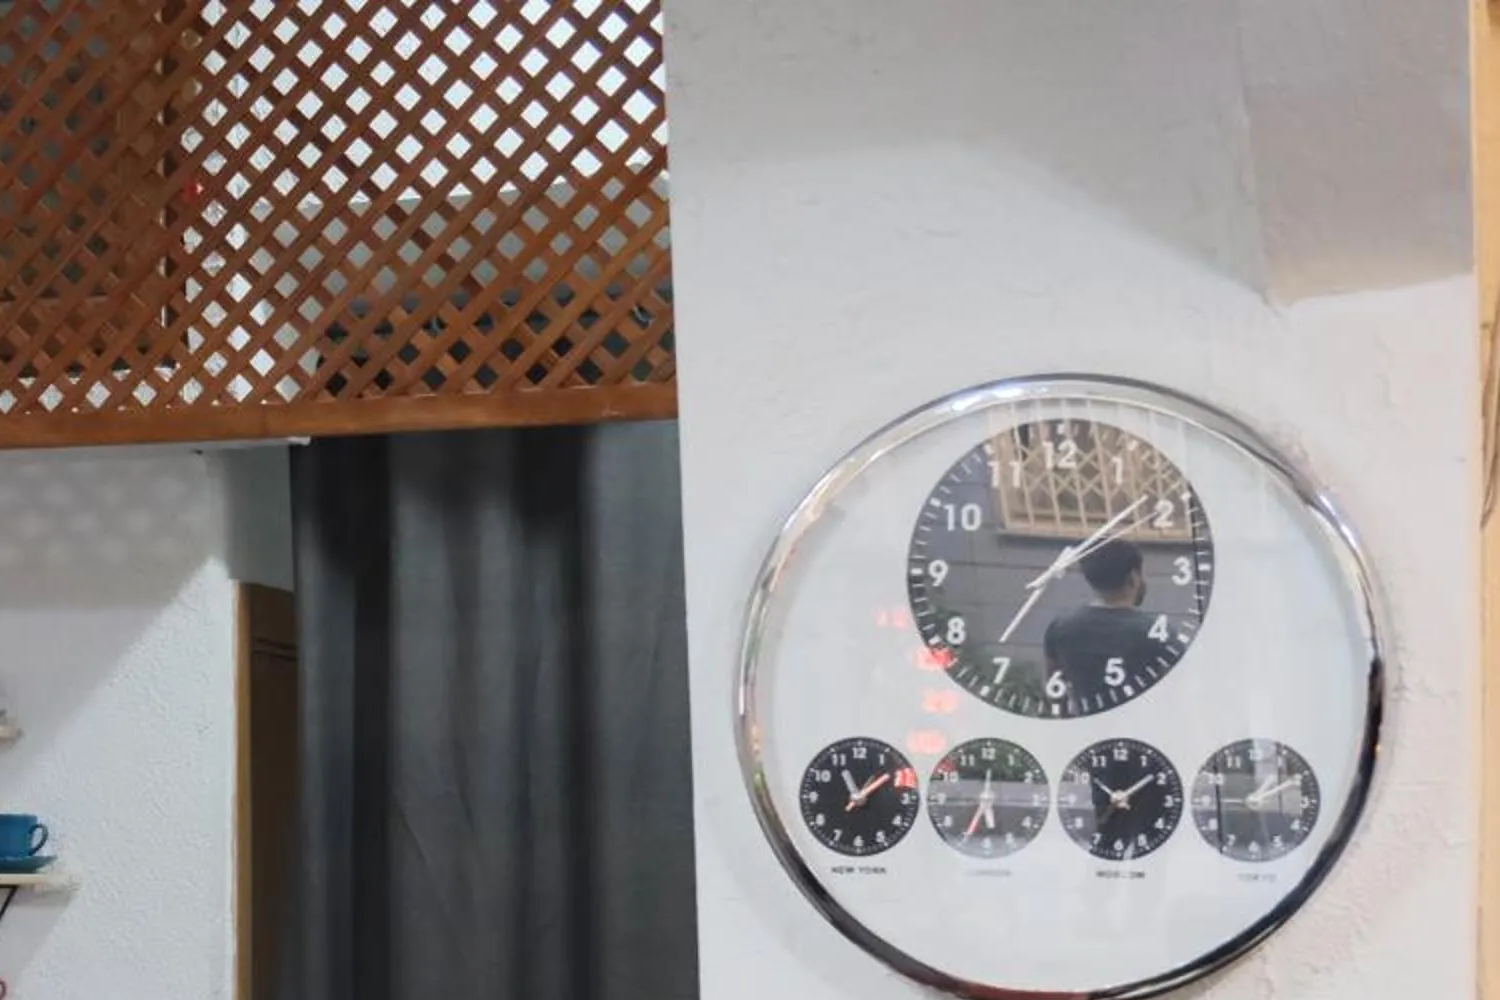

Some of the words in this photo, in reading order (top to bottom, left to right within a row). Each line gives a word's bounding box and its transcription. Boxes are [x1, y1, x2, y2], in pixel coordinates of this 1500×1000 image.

[1045, 440, 1077, 469] 12
[988, 461, 1022, 488] 11
[1113, 456, 1124, 484] 1
[944, 503, 981, 531] 10
[1153, 500, 1175, 527] 2
[928, 559, 948, 587] 9
[1171, 556, 1192, 585] 3
[946, 616, 966, 644] 8
[1148, 614, 1169, 642] 4
[993, 656, 1011, 684] 7
[1104, 657, 1126, 685] 5
[1046, 670, 1066, 698] 6
[832, 753, 846, 766] 11
[852, 746, 868, 759] 12
[961, 754, 975, 766] 11
[981, 747, 996, 759] 12
[1092, 755, 1106, 767] 11
[1113, 748, 1128, 761] 12
[1227, 755, 1241, 768] 11
[815, 769, 831, 783] 10
[1156, 771, 1166, 785] 2
[1163, 794, 1174, 808] 3
[1154, 817, 1164, 829] 4
[833, 828, 842, 841] 7
